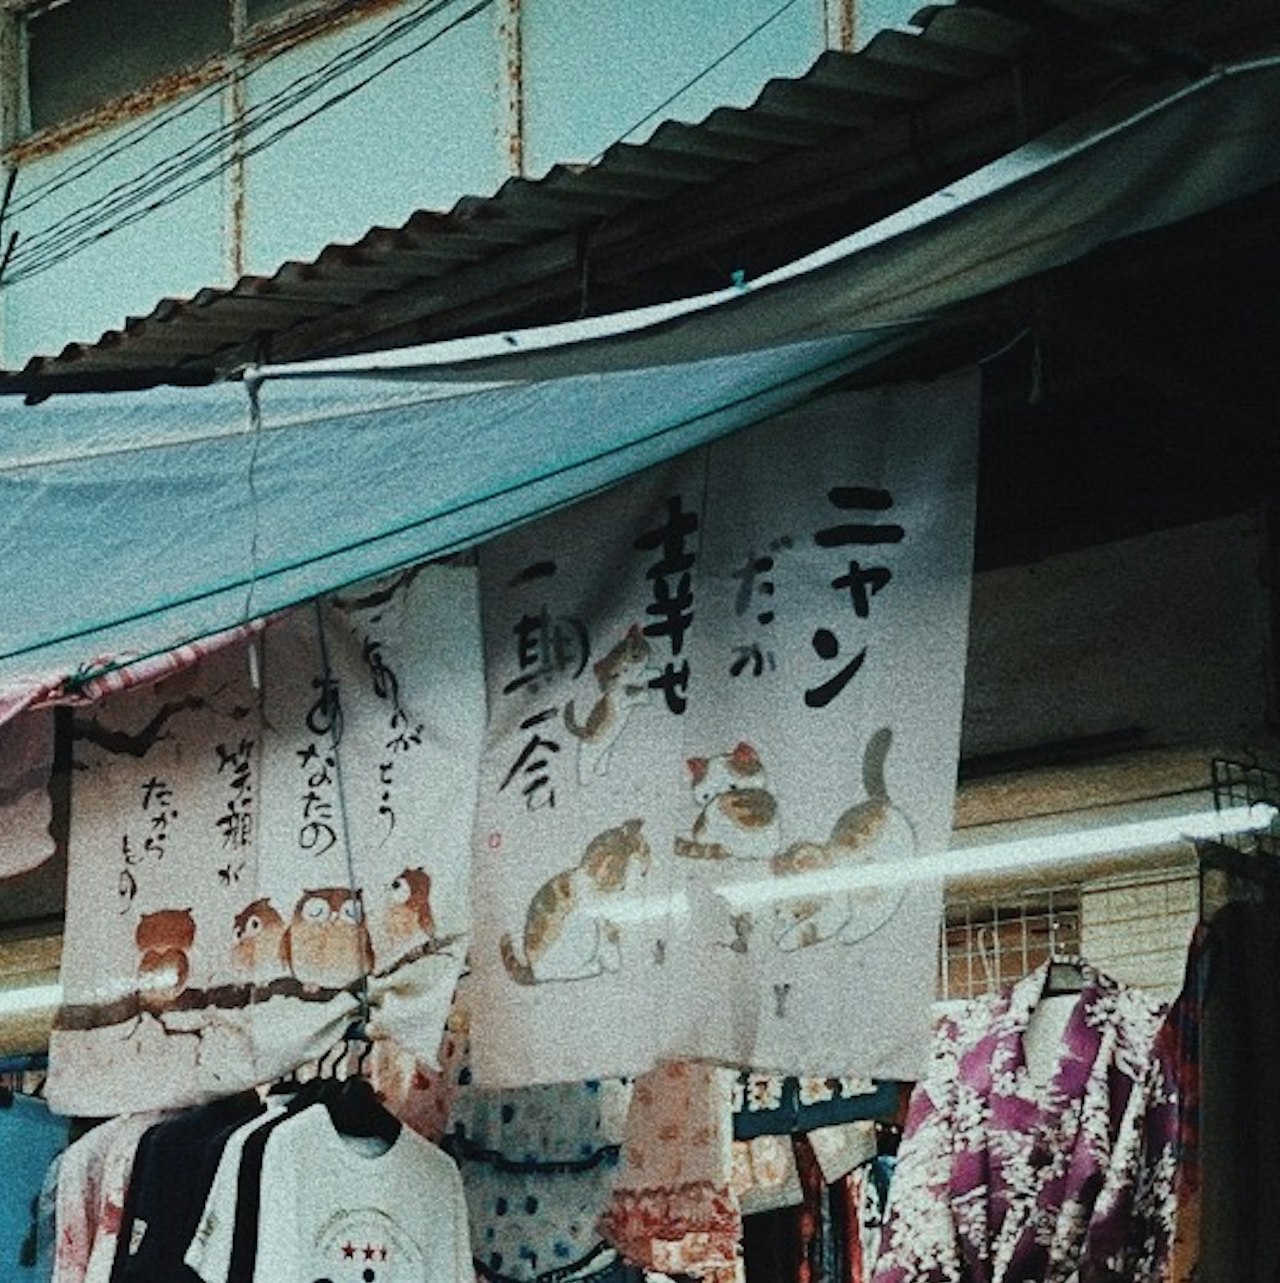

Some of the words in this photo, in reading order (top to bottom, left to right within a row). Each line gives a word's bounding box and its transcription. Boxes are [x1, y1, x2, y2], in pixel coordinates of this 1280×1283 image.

[498, 559, 592, 813] 一期一会
[634, 495, 700, 716] 幸せ
[297, 672, 344, 857] あなたの
[363, 634, 425, 850] ありがとう
